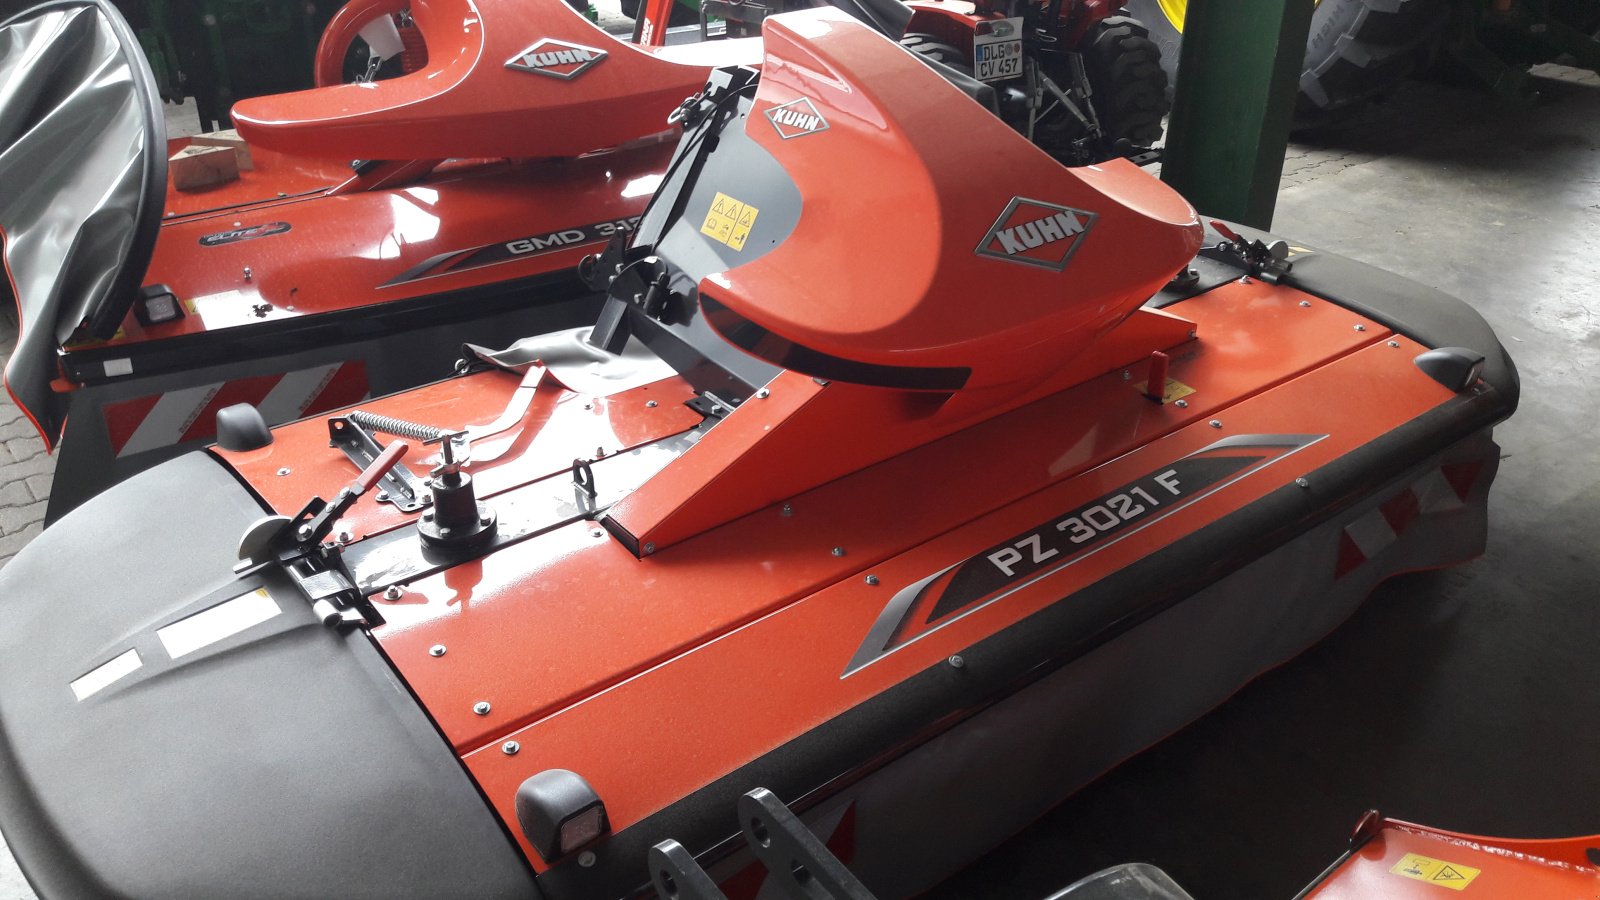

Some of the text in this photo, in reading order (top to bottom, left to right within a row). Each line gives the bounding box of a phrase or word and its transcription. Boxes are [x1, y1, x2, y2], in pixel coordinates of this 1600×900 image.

[523, 49, 594, 68] KUHN
[984, 45, 1005, 61] DLG
[981, 58, 1018, 77] CV 457
[773, 108, 820, 131] KUHN
[506, 217, 641, 254] GMD 312
[995, 210, 1085, 255] KUHN
[987, 469, 1181, 577] PZ 3021 F
